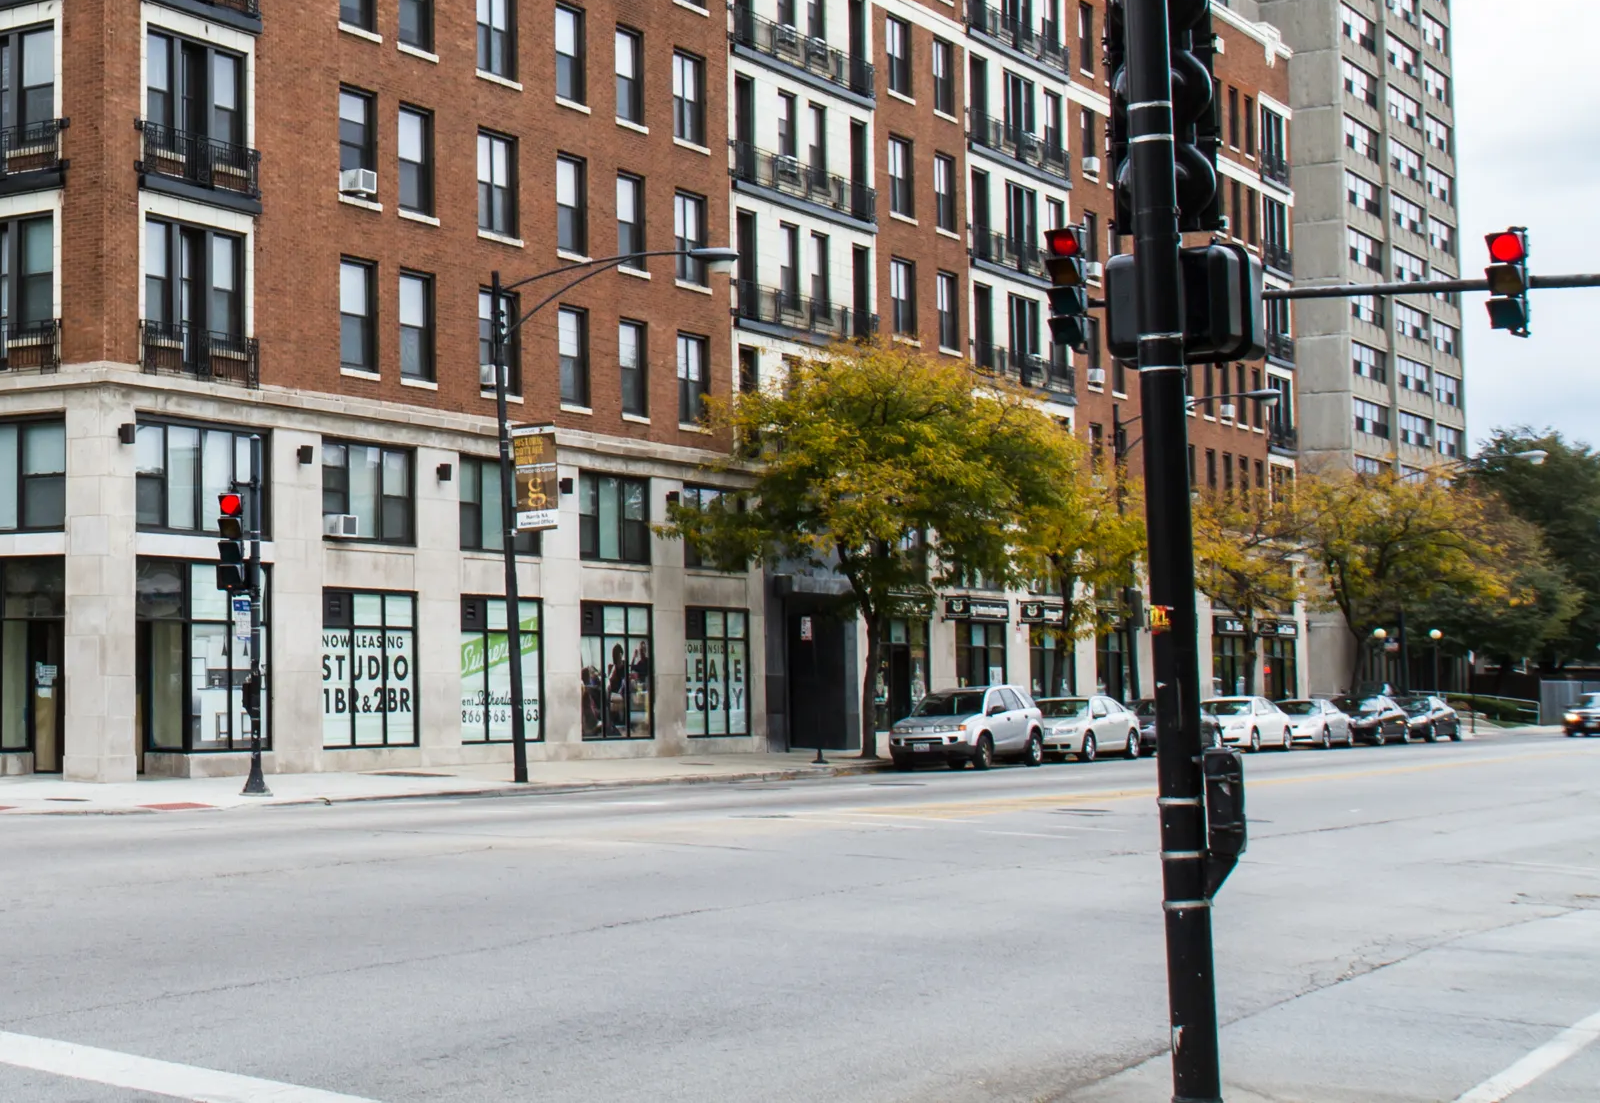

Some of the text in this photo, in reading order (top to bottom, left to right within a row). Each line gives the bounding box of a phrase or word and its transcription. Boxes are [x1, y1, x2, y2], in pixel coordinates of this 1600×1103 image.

[322, 634, 404, 649] NOW LEASNG
[685, 644, 703, 654] OME
[686, 658, 743, 683] LEAE
